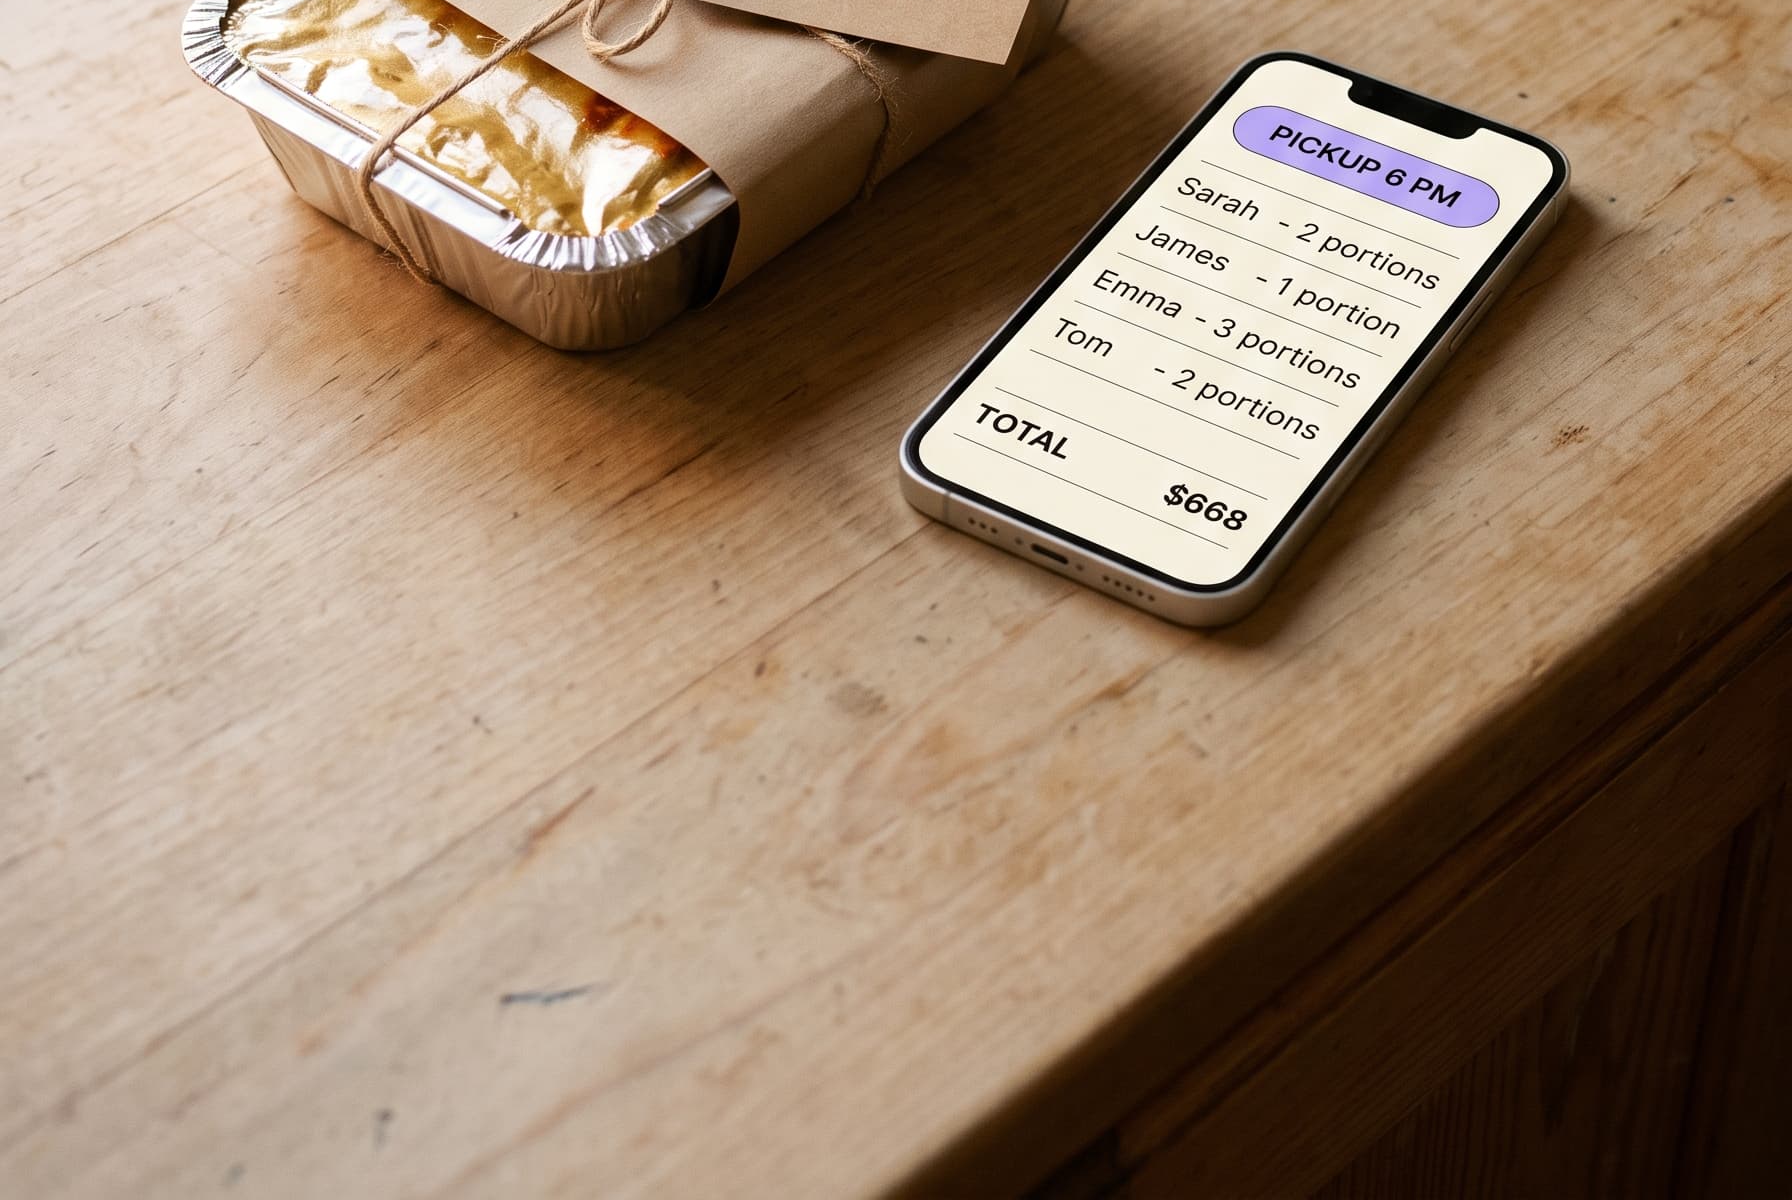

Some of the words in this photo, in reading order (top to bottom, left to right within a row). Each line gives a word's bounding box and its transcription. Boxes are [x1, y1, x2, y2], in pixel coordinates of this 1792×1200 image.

[1268, 124, 1382, 175] PICKUP
[1384, 168, 1408, 187] 6
[1408, 176, 1463, 210] PM
[1135, 225, 1230, 272] James
[1278, 277, 1294, 296] 1
[1292, 287, 1402, 340] portion
[1177, 177, 1260, 221] Sarah
[1296, 223, 1319, 243] 2
[1317, 235, 1441, 290] portions
[1054, 317, 1114, 357] Tom
[1171, 369, 1196, 390] 2
[1194, 382, 1321, 441] portions
[1092, 269, 1183, 319] Emma
[1213, 318, 1236, 339] 3
[1235, 331, 1361, 389] portions
[976, 402, 1068, 460] TOTAL
[1162, 482, 1248, 531] $668
